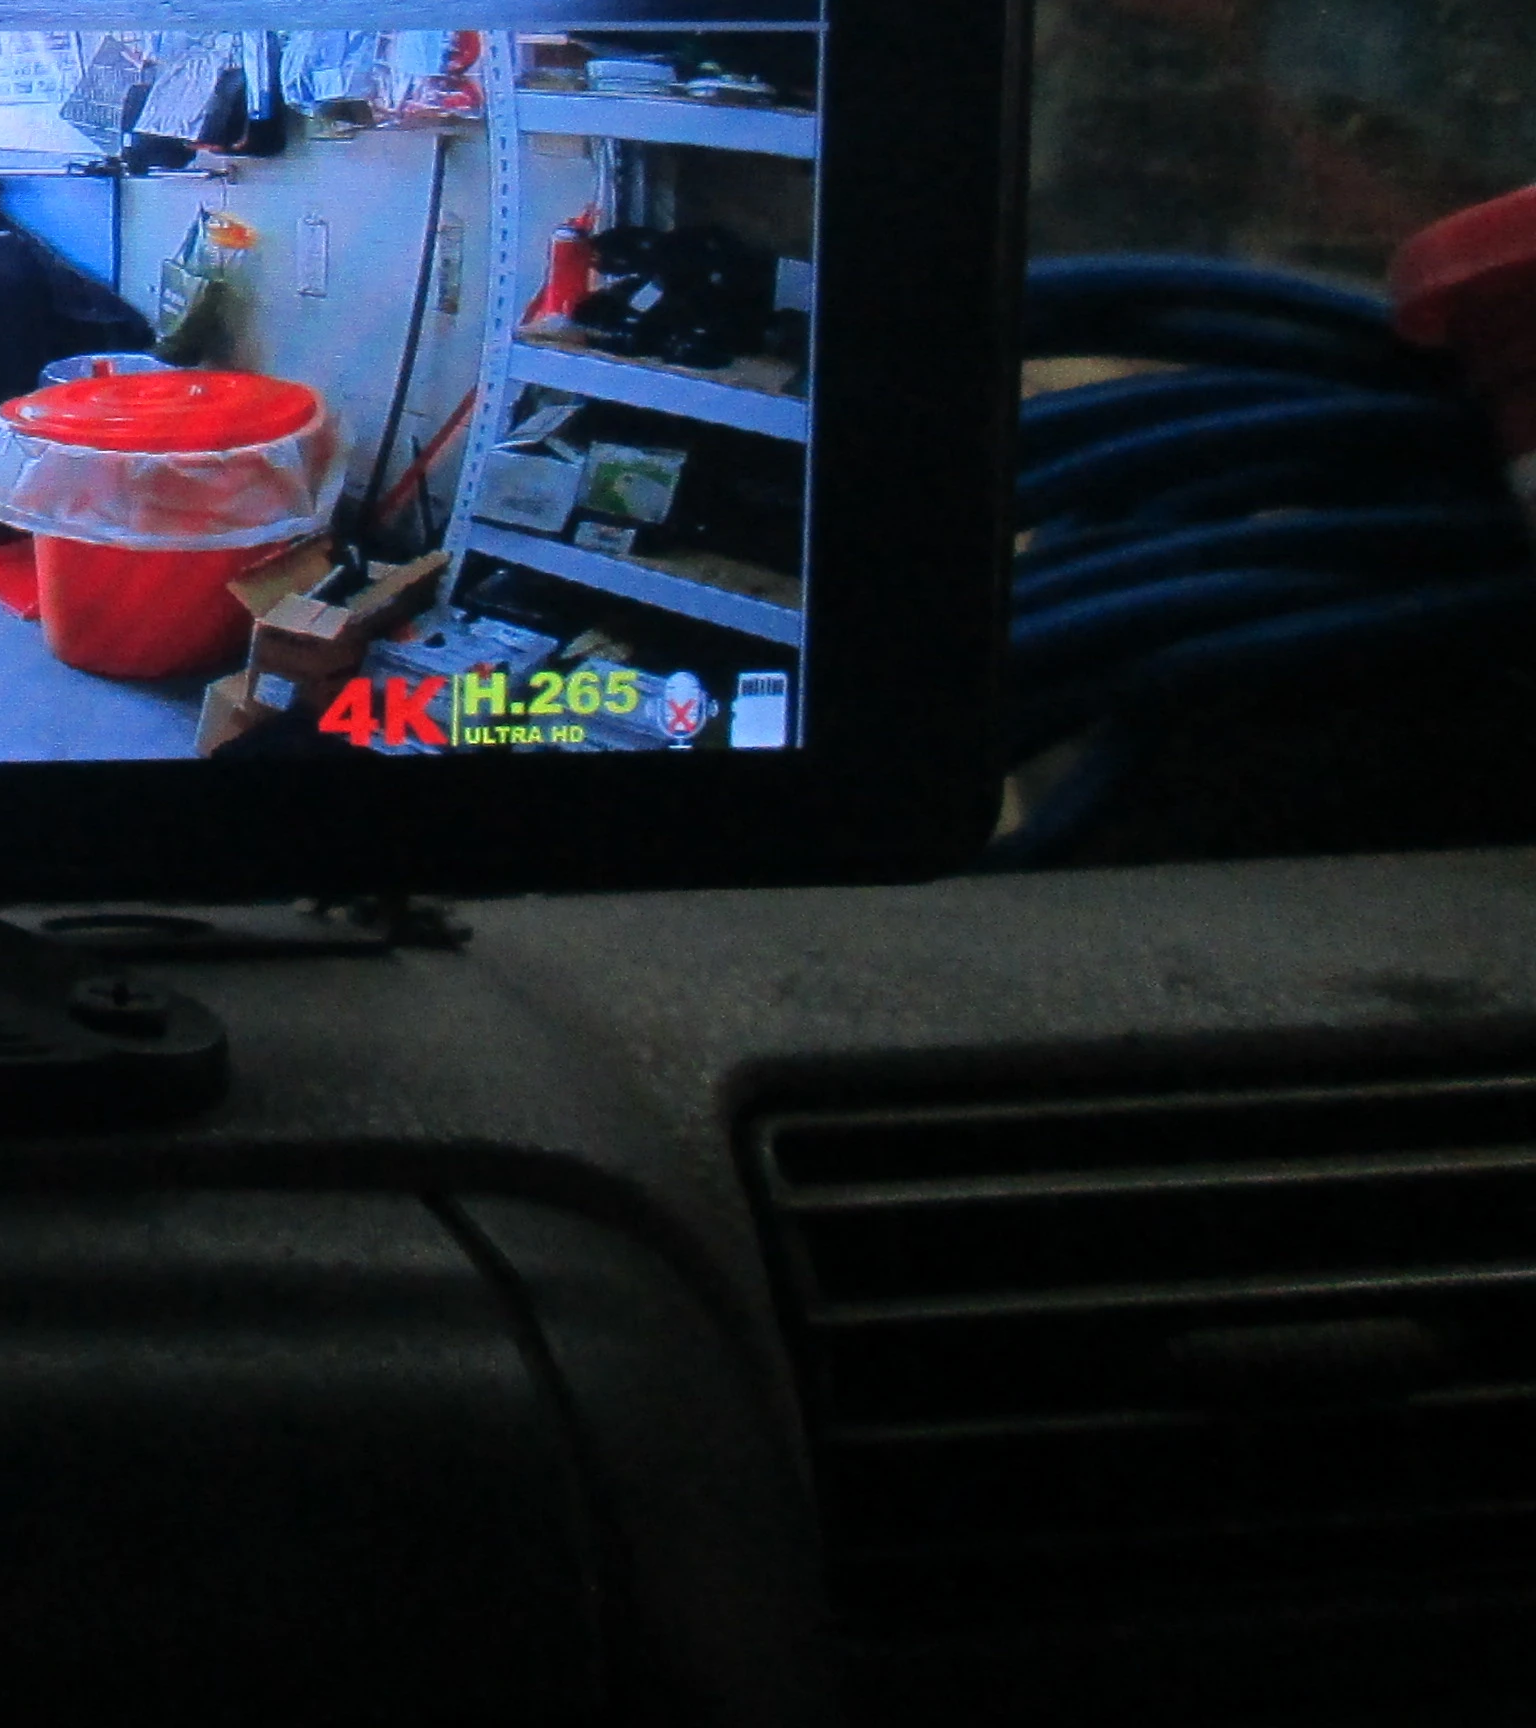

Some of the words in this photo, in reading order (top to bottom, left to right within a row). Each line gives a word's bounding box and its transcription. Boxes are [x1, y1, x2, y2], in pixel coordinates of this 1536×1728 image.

[318, 674, 448, 747] 4K
[464, 670, 639, 715] H.265
[464, 725, 540, 746] ULTRA
[551, 725, 585, 744] HD
